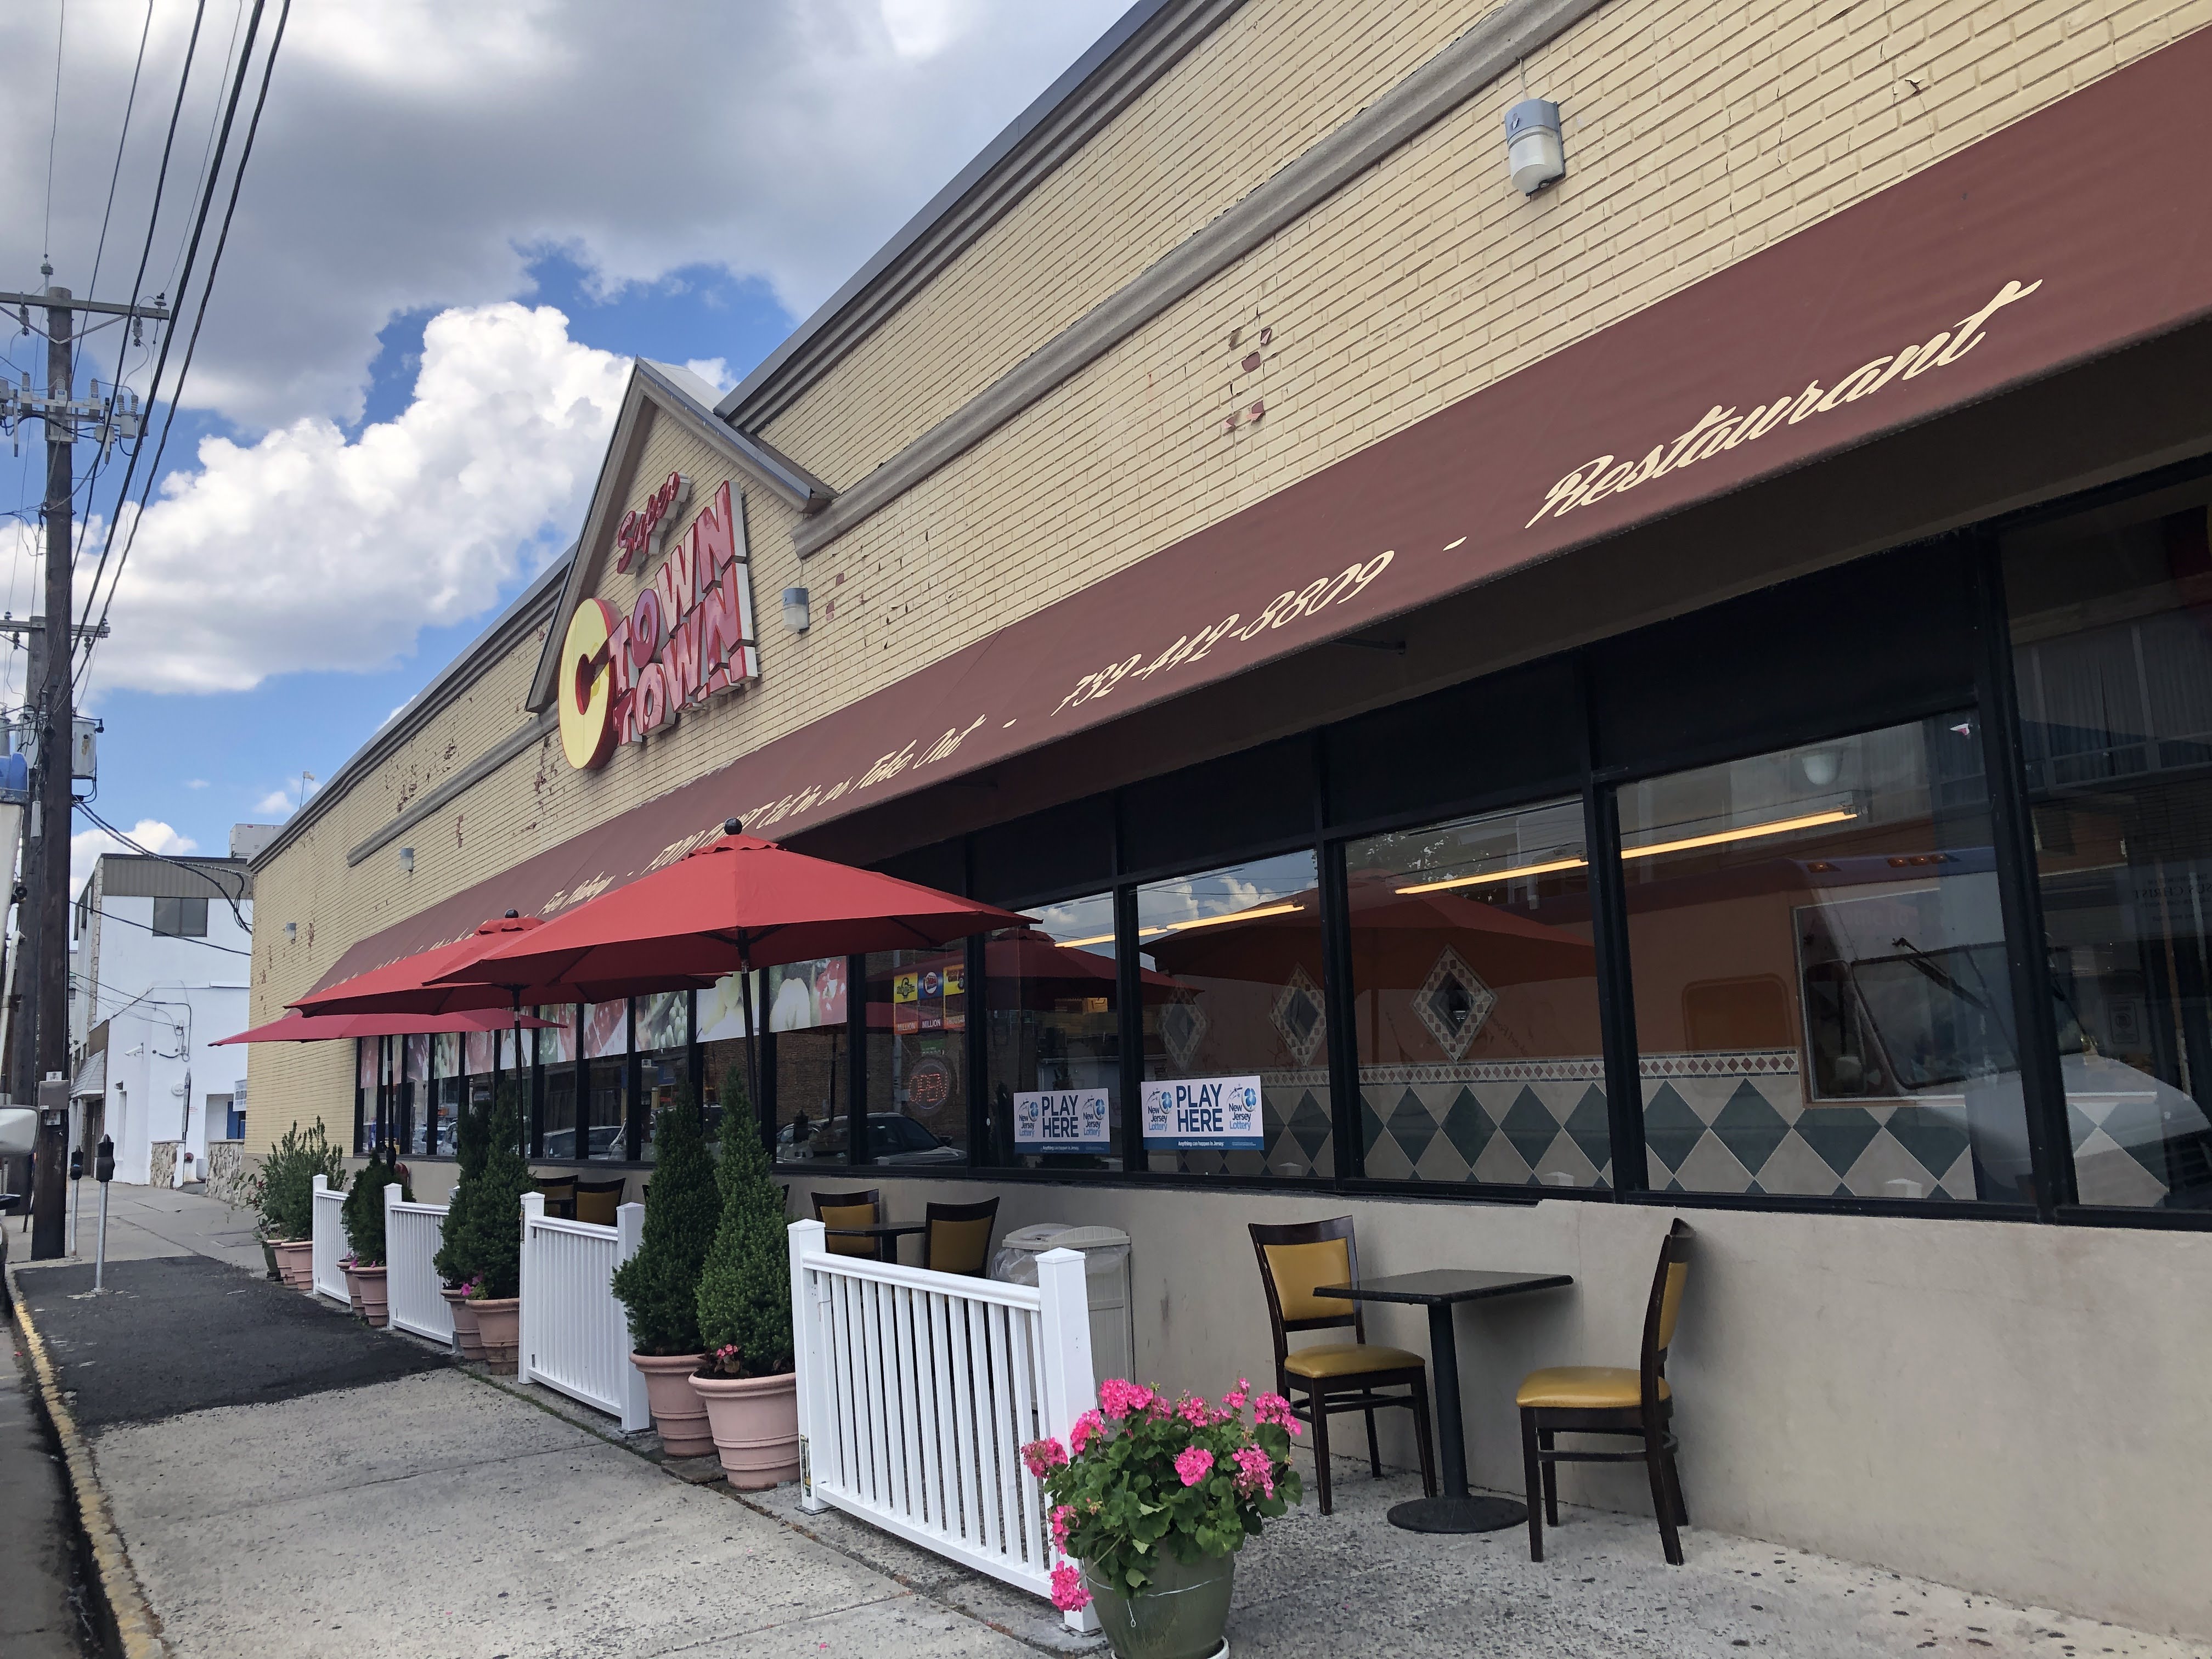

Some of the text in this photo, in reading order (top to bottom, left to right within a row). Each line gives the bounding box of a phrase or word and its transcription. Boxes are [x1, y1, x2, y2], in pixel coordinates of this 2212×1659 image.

[617, 471, 682, 574] Super
[756, 785, 811, 830] Eat
[790, 784, 822, 816] in
[817, 776, 853, 806] or
[848, 739, 917, 794] Take
[912, 714, 987, 770] Out
[1050, 550, 1395, 716] 732-442-8809
[1525, 279, 2044, 529] Restaurant
[922, 1019, 941, 1029] MILLION
[1176, 1083, 1222, 1108] PLAY
[1041, 1094, 1079, 1116] PLAY
[1228, 1103, 1243, 1112] New
[1083, 1112, 1094, 1120] New
[1151, 1114, 1167, 1123] Jersey
[1177, 1108, 1224, 1132] HERE
[1232, 1113, 1251, 1122] Jersey
[1042, 1116, 1079, 1138] HERE
[1086, 1121, 1101, 1129] Jersey
[1148, 1122, 1167, 1132] Lottery
[1229, 1121, 1251, 1131] Lottery
[1019, 1128, 1035, 1137] Lottery
[1084, 1127, 1101, 1137] Lottery
